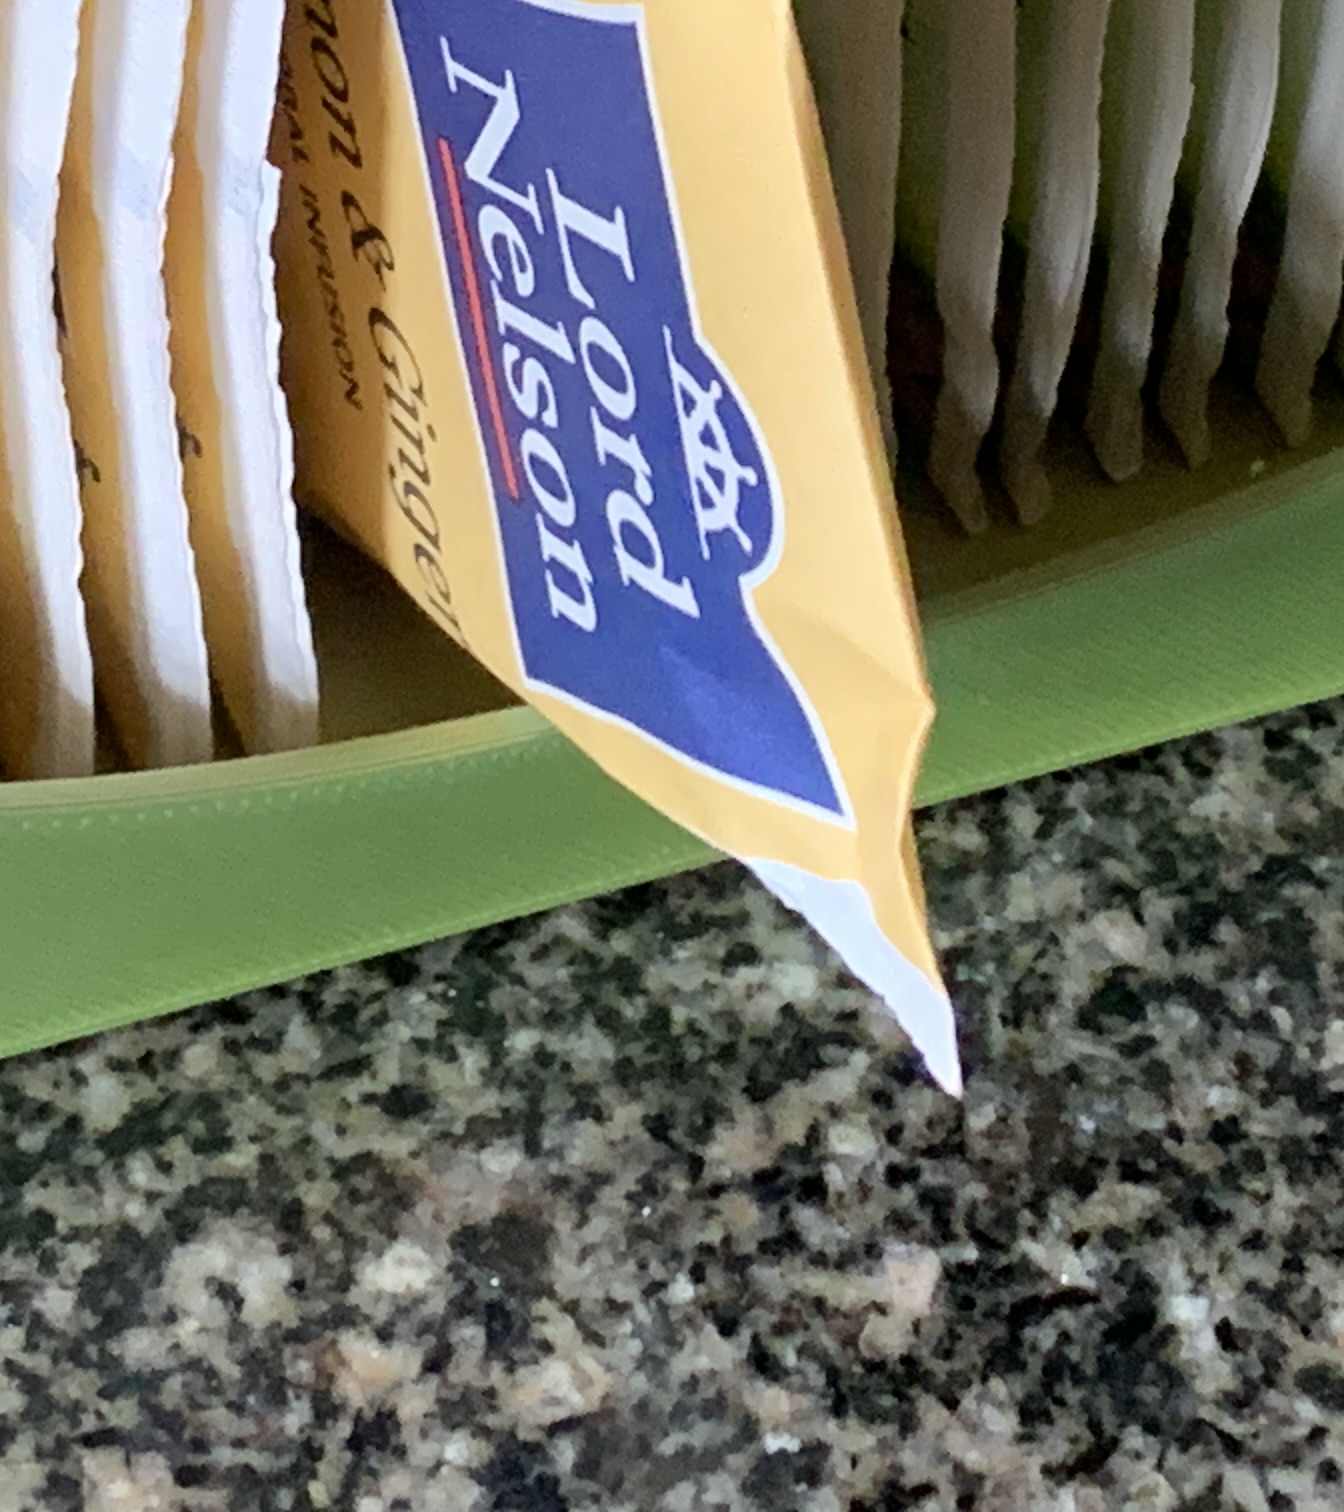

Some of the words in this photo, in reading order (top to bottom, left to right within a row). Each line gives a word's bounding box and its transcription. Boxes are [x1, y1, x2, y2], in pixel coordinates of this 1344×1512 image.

[299, 183, 363, 411] INFUSION
[341, 190, 395, 292] &
[439, 36, 599, 634] Nelson
[546, 167, 700, 620] Lord
